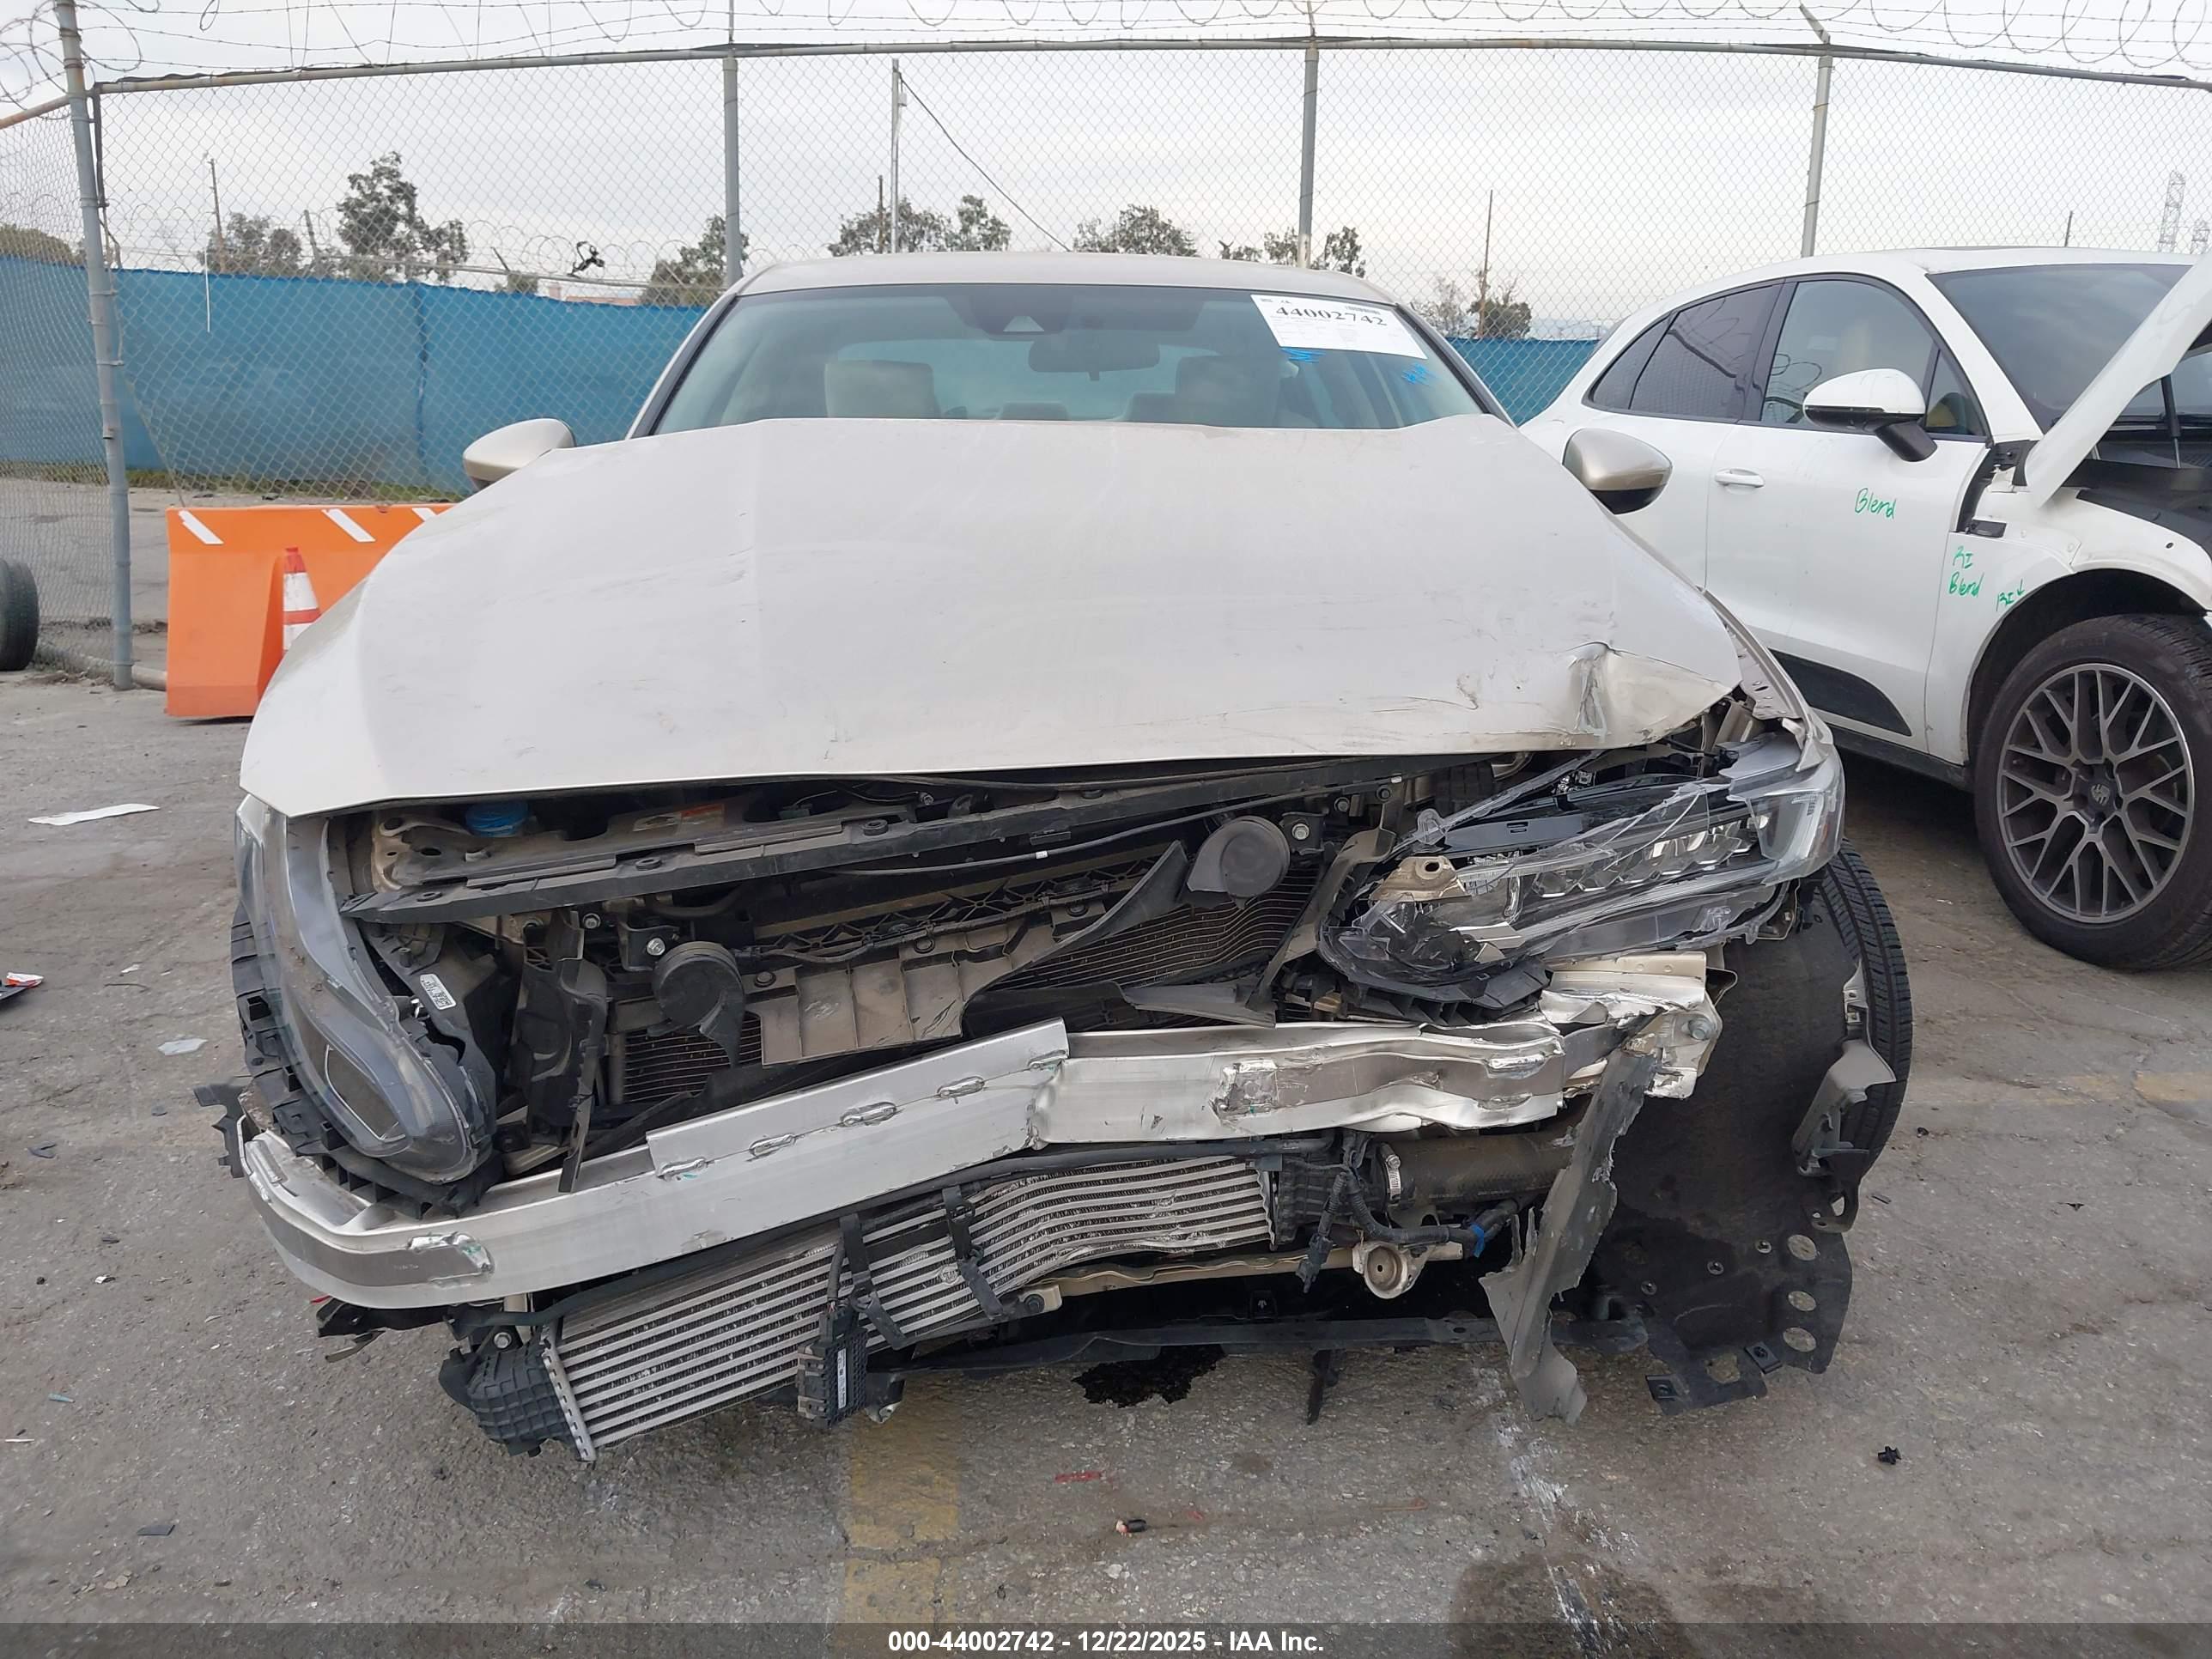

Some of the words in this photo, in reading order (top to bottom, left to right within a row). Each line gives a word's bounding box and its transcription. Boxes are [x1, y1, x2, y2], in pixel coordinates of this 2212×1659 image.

[1276, 307, 1387, 325] 44002742
[1855, 488, 1896, 519] Blend
[1948, 571, 1984, 597] Blend
